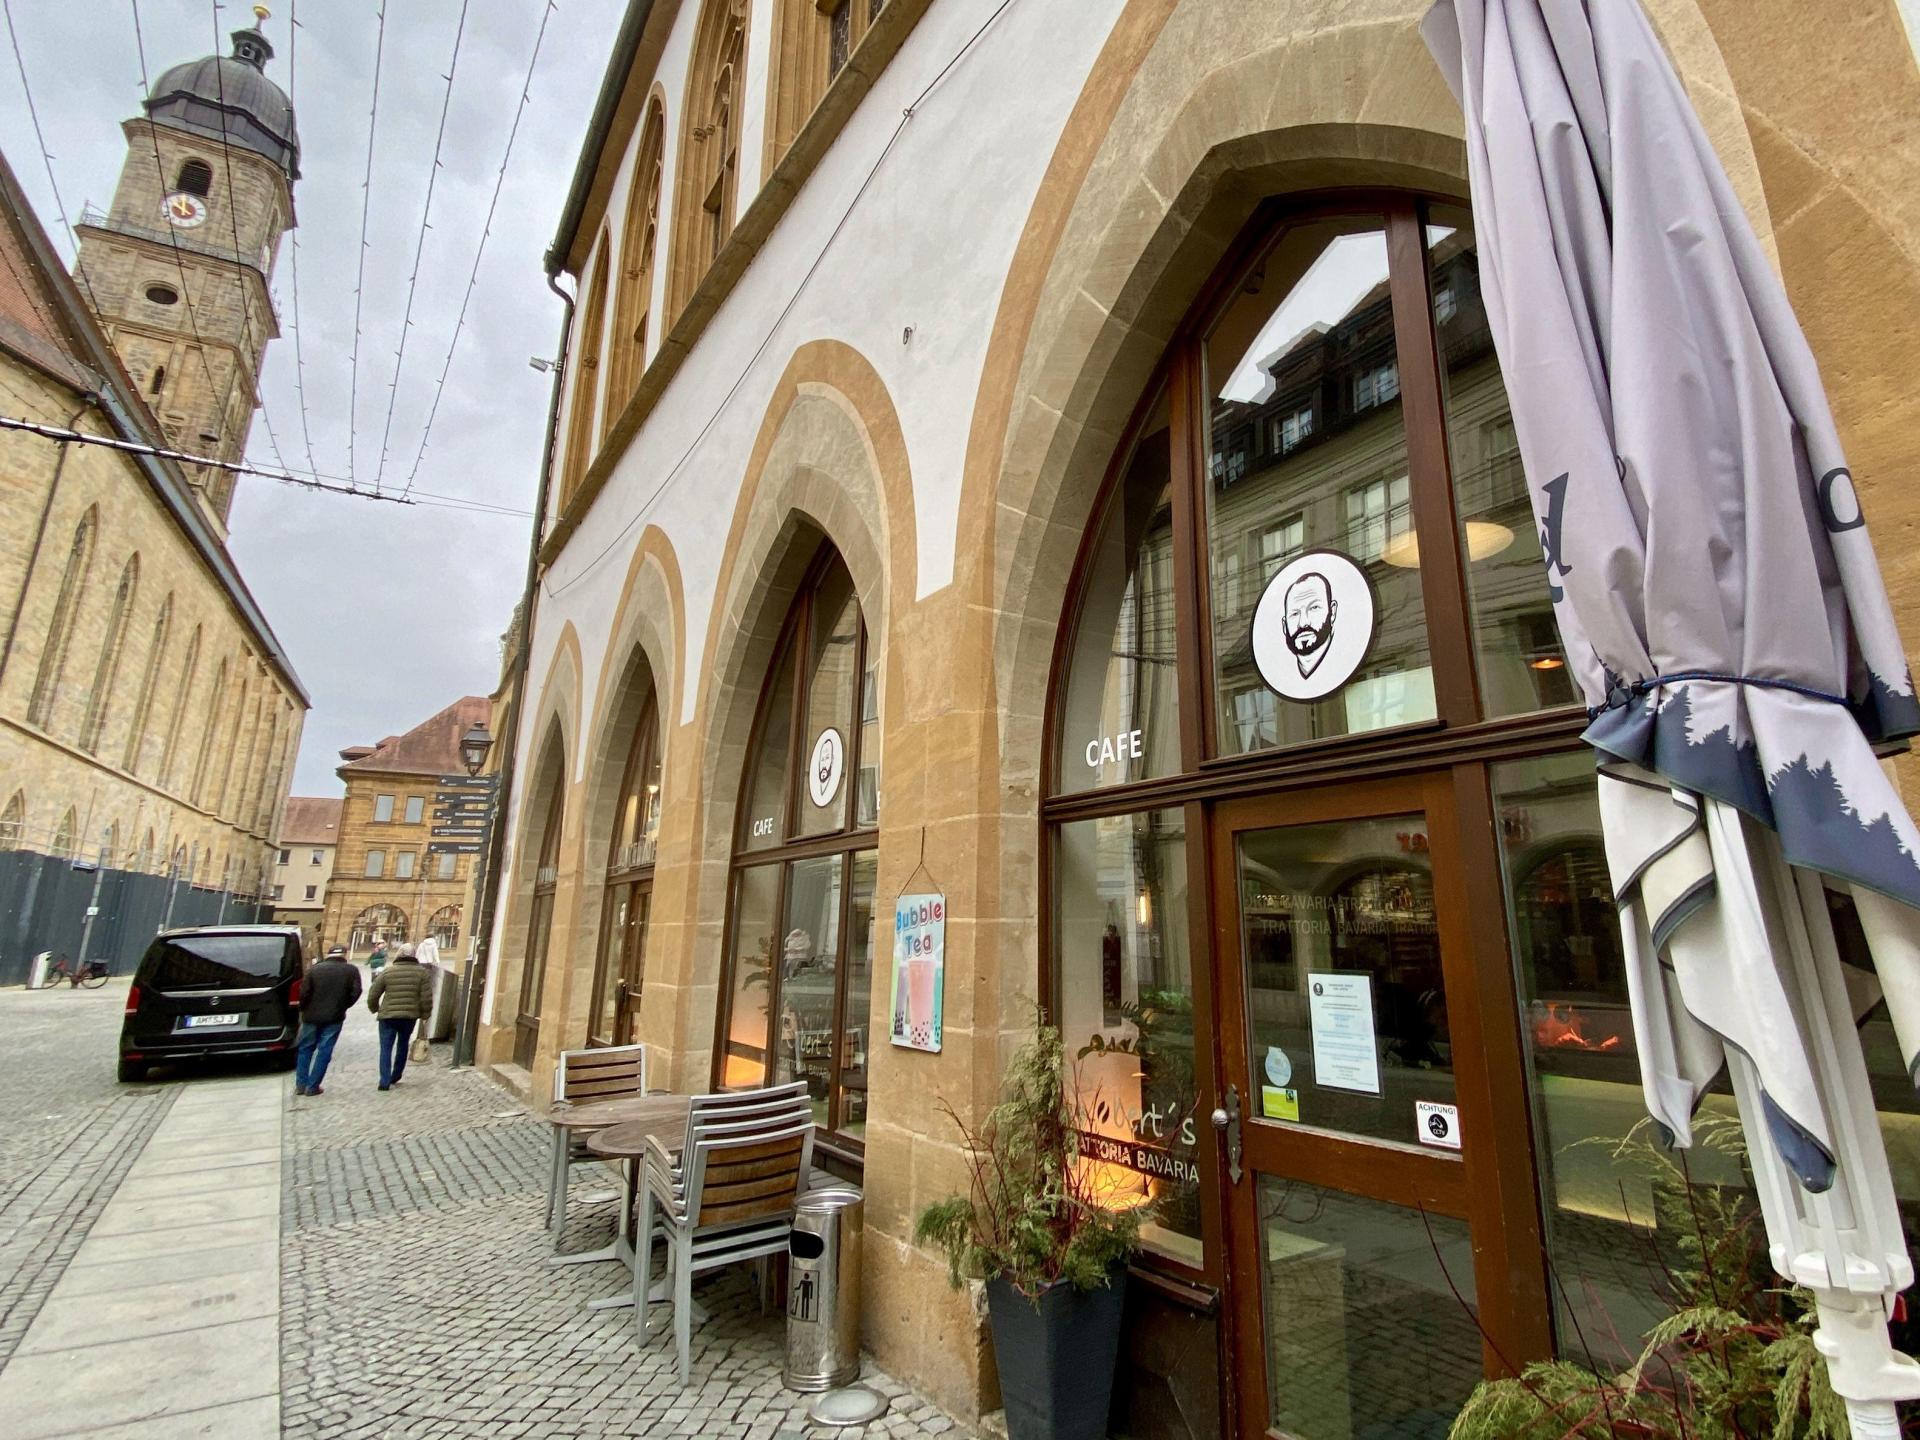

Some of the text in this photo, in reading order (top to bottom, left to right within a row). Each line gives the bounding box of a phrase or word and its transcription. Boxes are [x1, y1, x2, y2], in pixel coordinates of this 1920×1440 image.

[1085, 729, 1142, 767] CAFE
[753, 817, 773, 836] CAFE
[896, 900, 943, 932] Bubble
[904, 934, 933, 957] Tea
[1418, 1103, 1456, 1115] ACHTUNG!
[1137, 1150, 1200, 1183] BAVARIA
